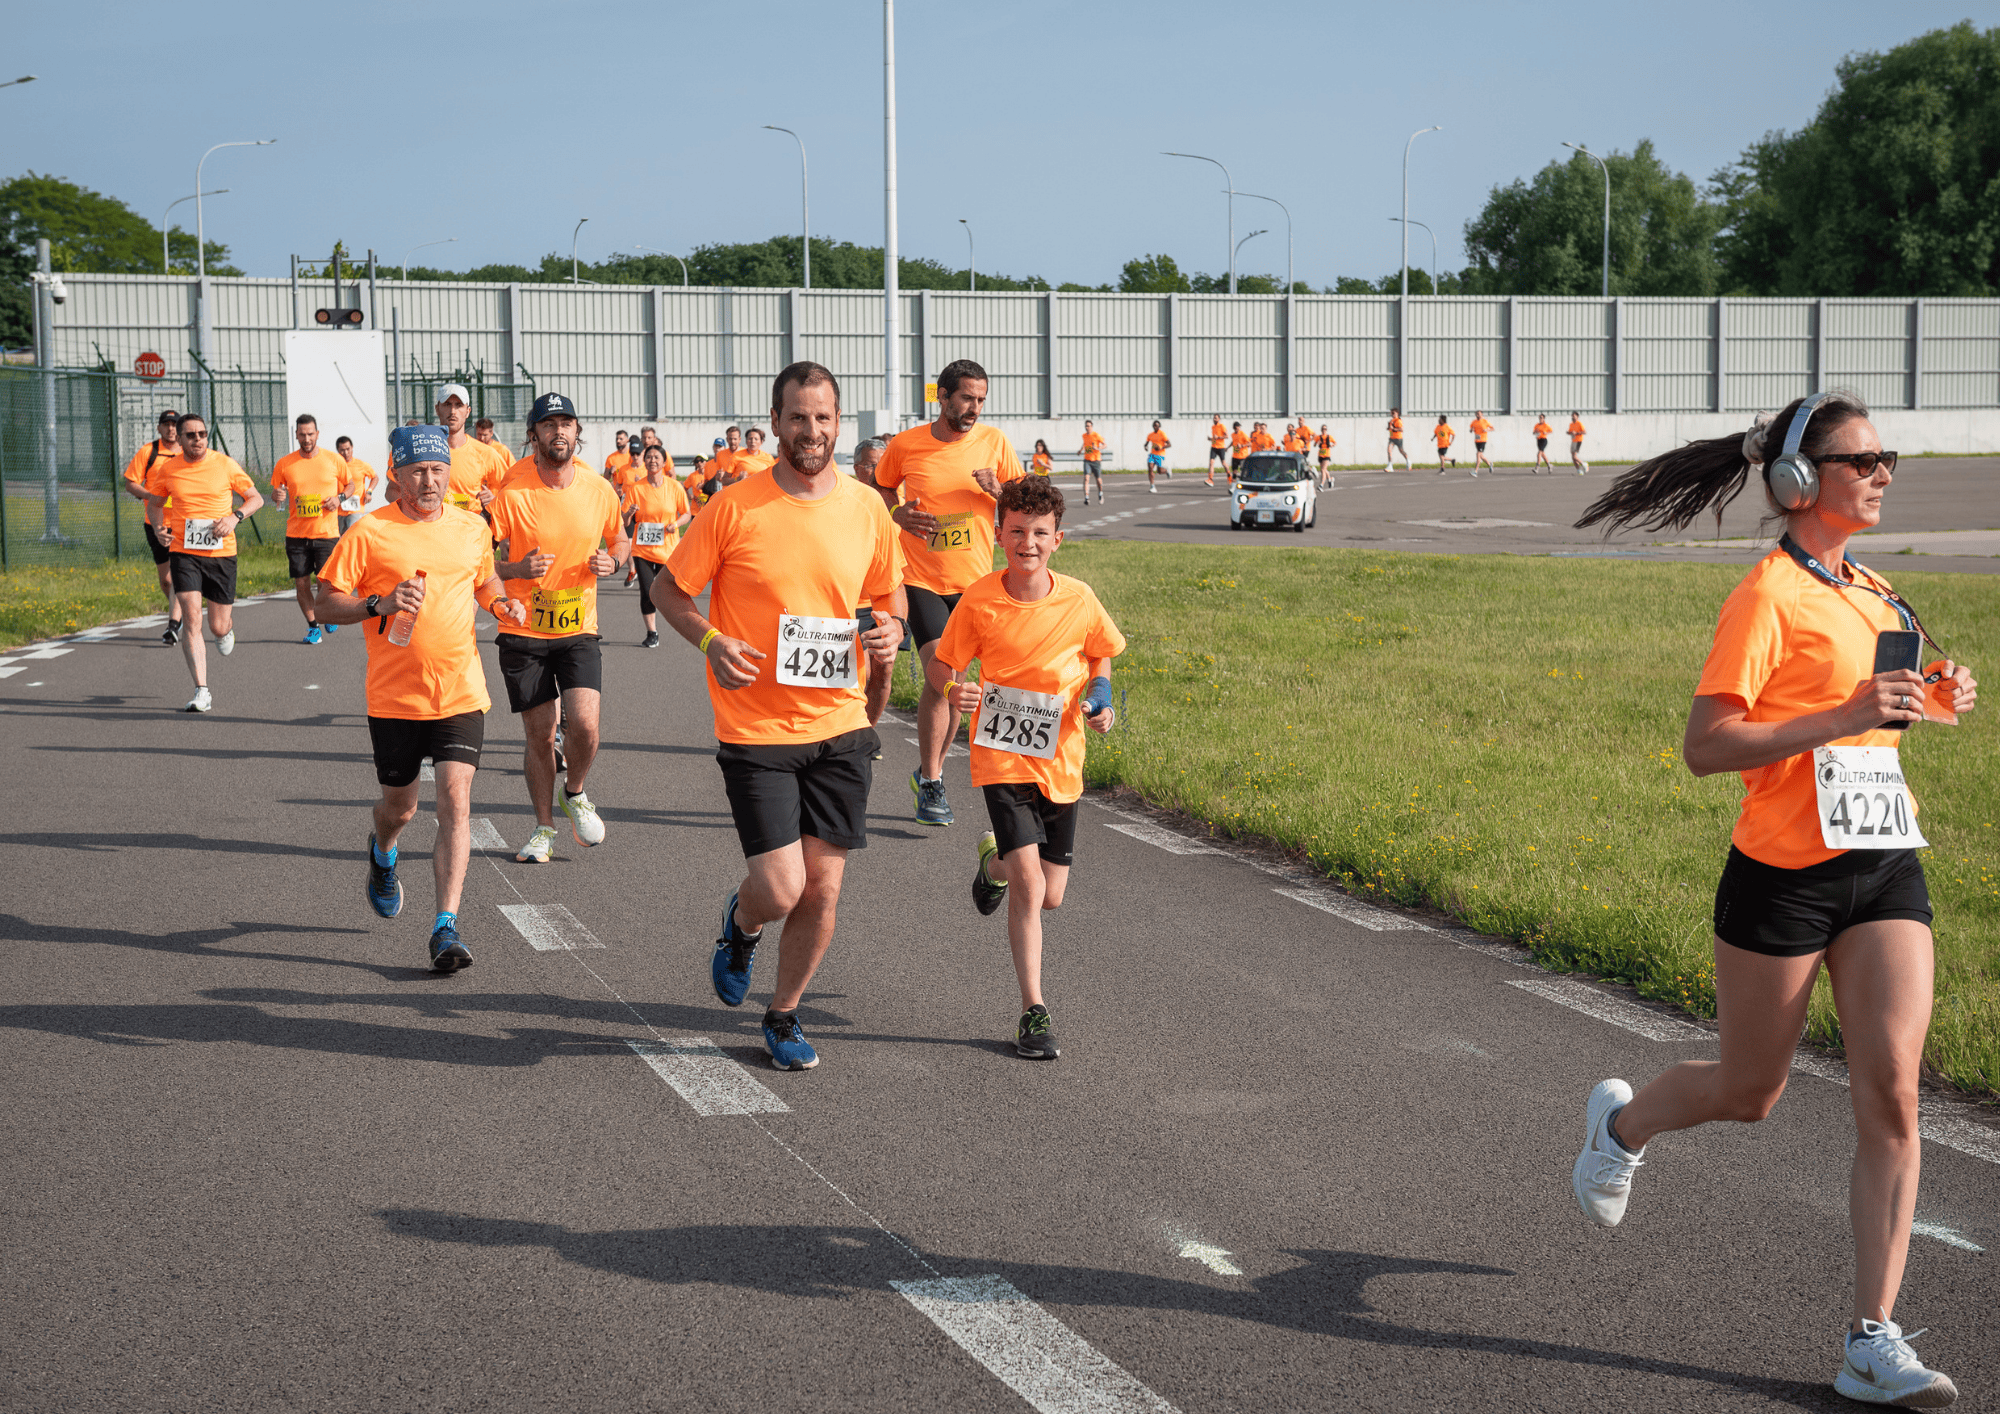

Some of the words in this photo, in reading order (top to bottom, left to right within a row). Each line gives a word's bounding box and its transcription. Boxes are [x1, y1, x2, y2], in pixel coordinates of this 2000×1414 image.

[136, 361, 164, 376] STOP
[187, 532, 219, 546] 4265
[638, 532, 662, 543] 4325
[929, 528, 971, 547] 7121
[541, 595, 582, 605] ULTRATIMING
[535, 607, 580, 629] 7164
[797, 631, 854, 642] ULTRATIMING
[784, 647, 850, 679] 4284
[997, 700, 1059, 719] ULTRATIMING
[984, 712, 1052, 750] 4285
[1839, 771, 1905, 784] ULTRATIMIN
[1829, 792, 1908, 836] 4220
